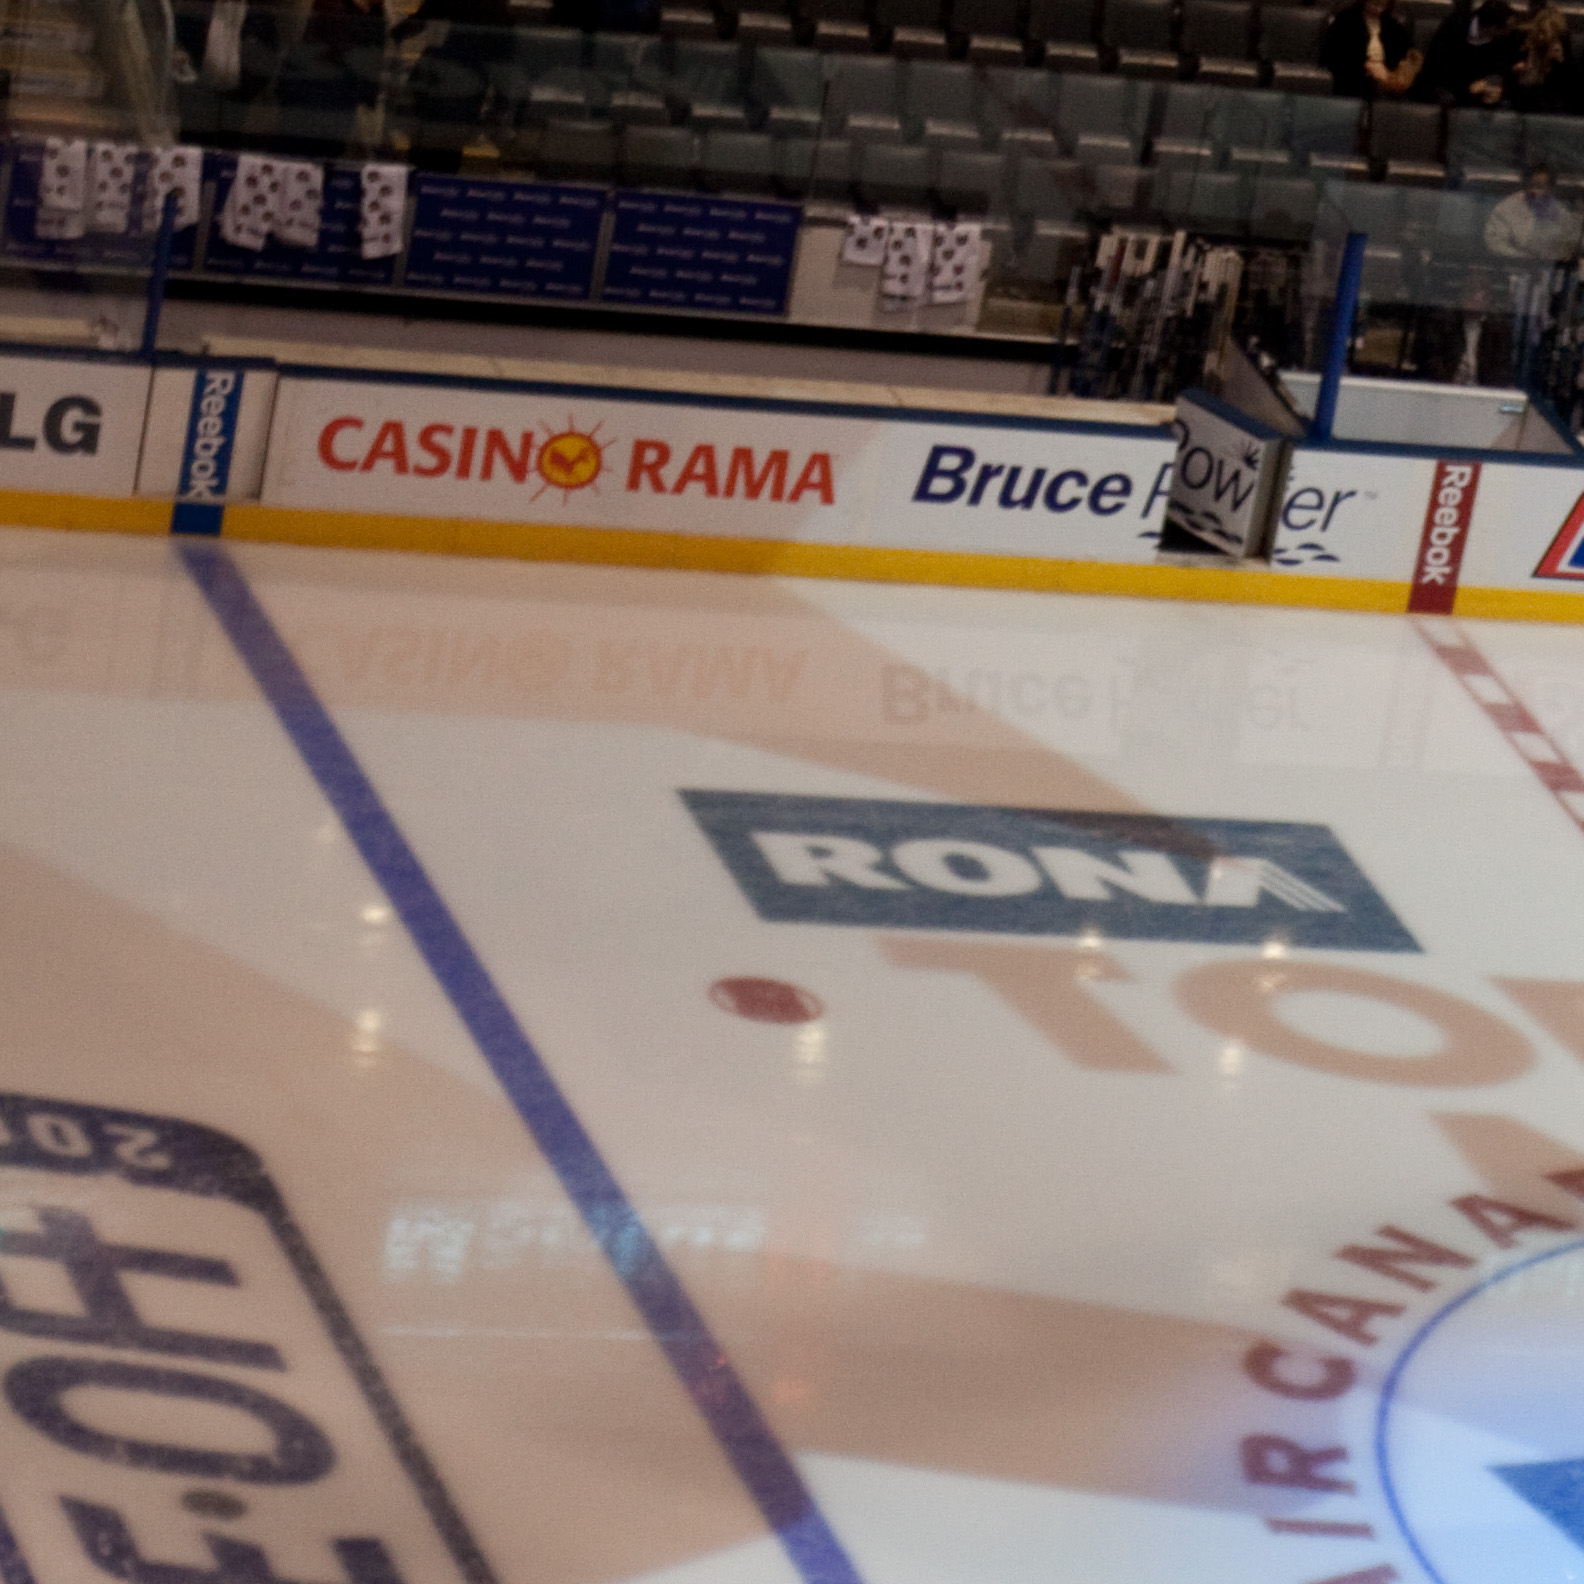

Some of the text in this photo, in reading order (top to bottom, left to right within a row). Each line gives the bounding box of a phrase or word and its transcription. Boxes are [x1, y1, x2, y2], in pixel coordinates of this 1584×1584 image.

[177, 370, 237, 500] Reebok
[625, 437, 837, 506] RAMA
[911, 443, 1135, 518] Bruce
[1420, 462, 1474, 586] Reebok
[746, 828, 1350, 915] RONA
